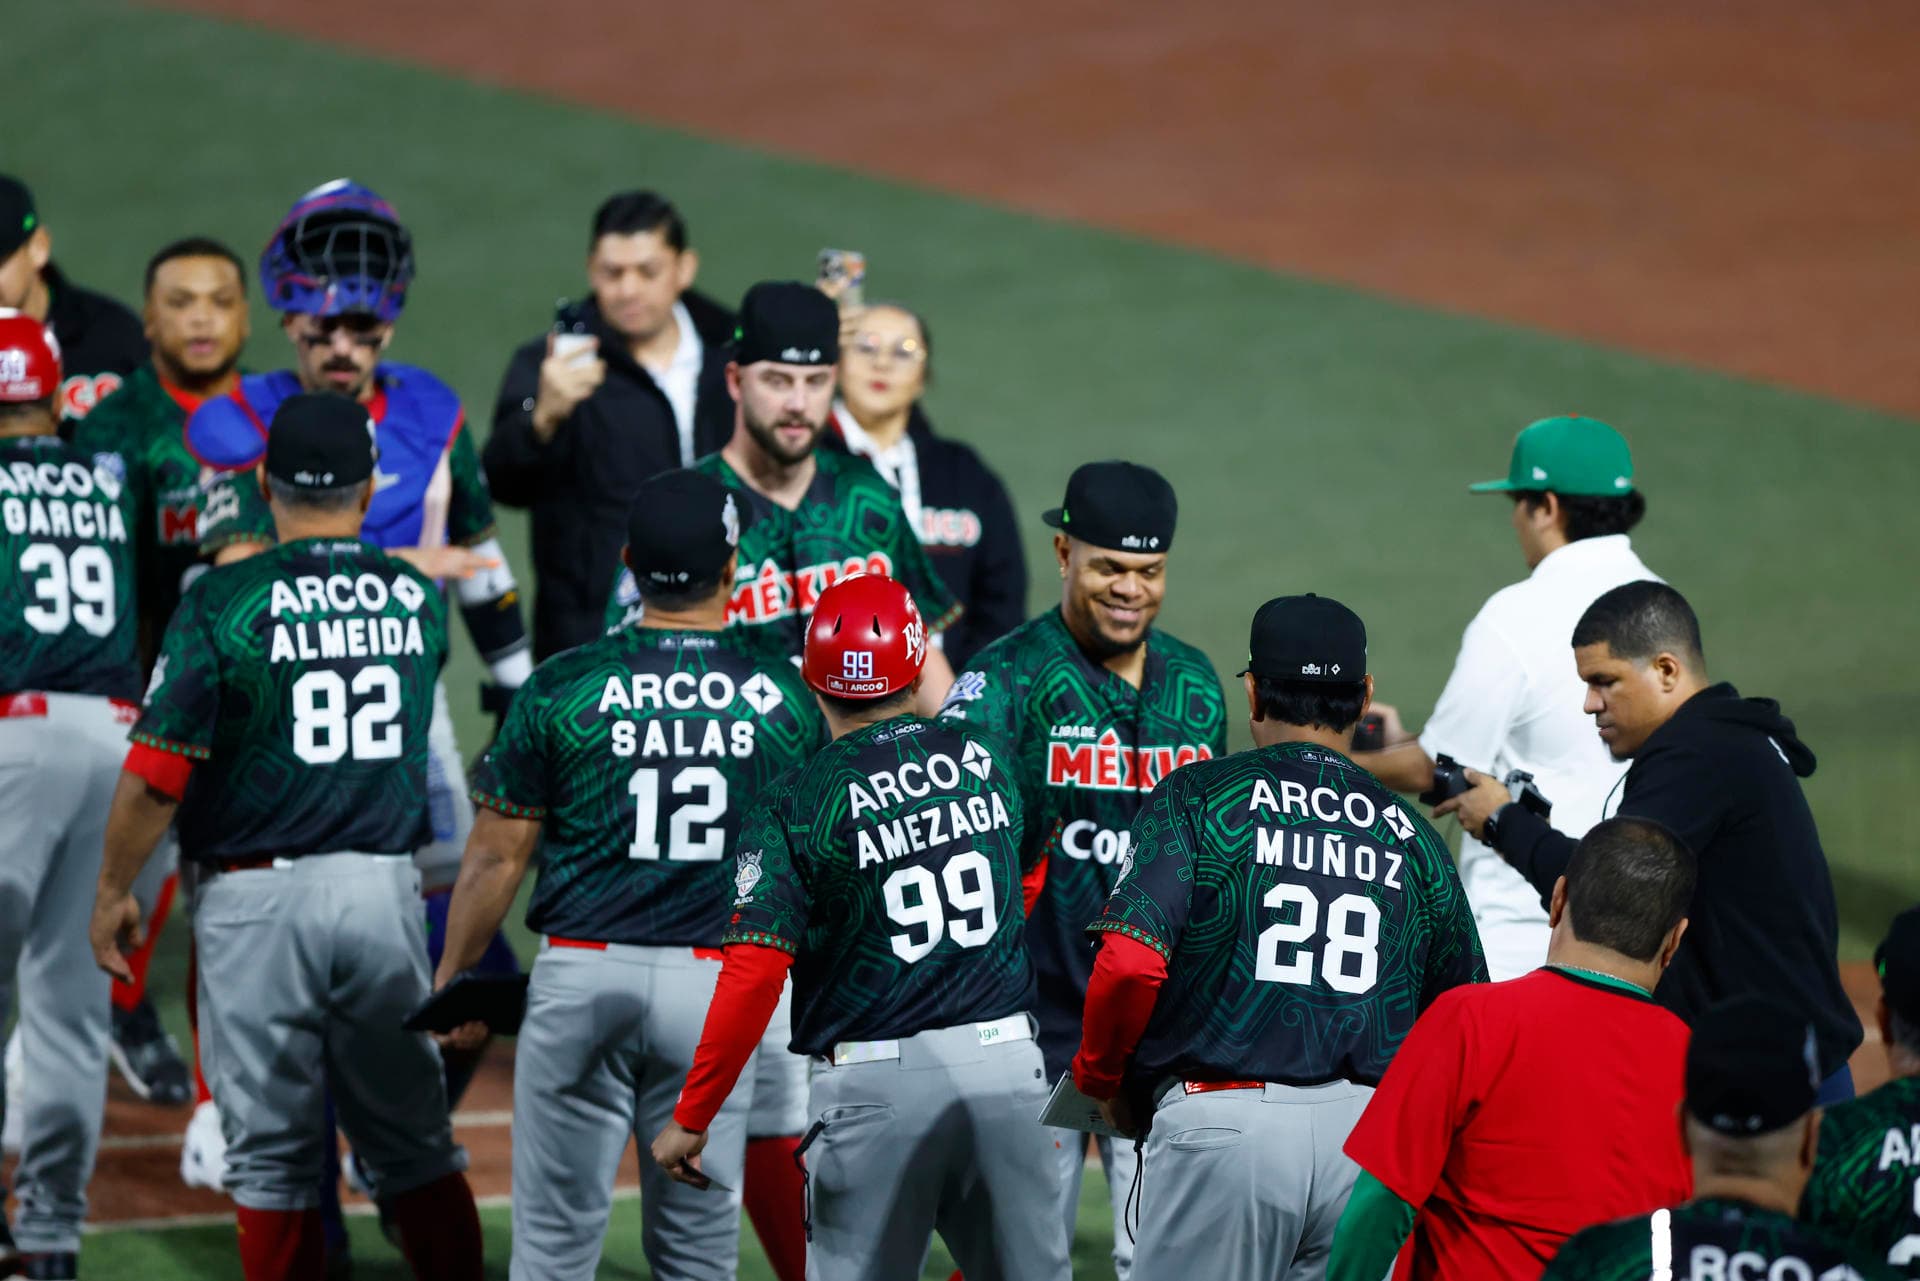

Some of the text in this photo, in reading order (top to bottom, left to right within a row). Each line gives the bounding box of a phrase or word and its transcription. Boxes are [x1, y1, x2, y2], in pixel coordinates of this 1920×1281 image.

[0, 462, 94, 498] ARCO
[3, 497, 127, 544] GARCIA
[20, 543, 115, 637] 39
[270, 574, 389, 618] ARCO
[270, 617, 424, 663] ALMEIDA
[843, 651, 873, 679] 99
[598, 671, 735, 713] ARCO
[850, 683, 875, 692] ARCO
[292, 665, 402, 765] 82
[611, 719, 755, 758] SALAS
[1047, 727, 1213, 793] MÉXI
[848, 752, 960, 819] ARCO
[1248, 779, 1376, 829] ARCO
[628, 766, 728, 862] 12
[857, 791, 1011, 869] AMEZAGA
[1254, 827, 1403, 890] MUÑOZ
[882, 850, 999, 964] 99
[1254, 882, 1381, 995] 28
[1680, 1243, 1814, 1281] RCO
